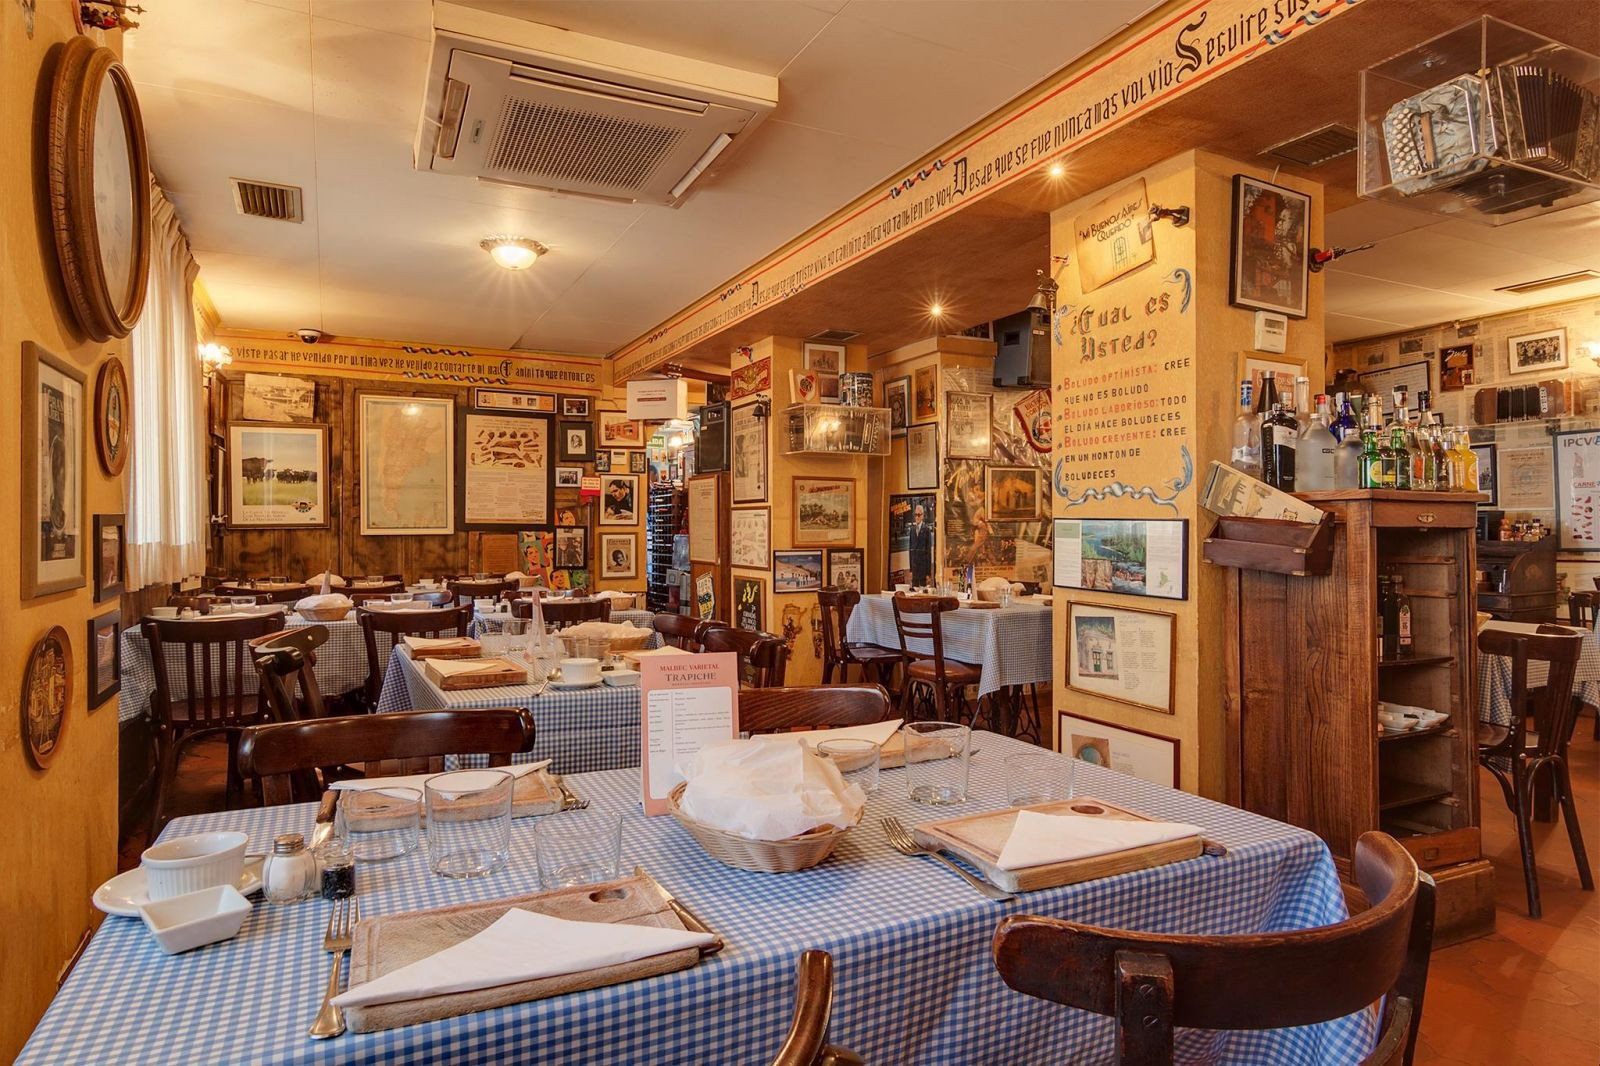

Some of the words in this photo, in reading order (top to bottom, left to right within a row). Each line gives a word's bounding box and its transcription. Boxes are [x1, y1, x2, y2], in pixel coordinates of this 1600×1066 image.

[952, 157, 993, 200] Desde
[1054, 107, 1092, 148] nunca
[1094, 92, 1119, 125] mas
[1144, 292, 1171, 316] es
[1164, 357, 1191, 371] CREE
[1083, 392, 1094, 403] NO
[1097, 389, 1109, 400] ES
[1111, 383, 1149, 398] BOLUDO
[1161, 395, 1187, 407] TODO
[1064, 424, 1074, 434] EL
[1095, 419, 1118, 430] HACE
[1121, 411, 1181, 427] BOLUDECES
[1160, 426, 1187, 437] CREE
[1065, 455, 1076, 463] EN
[1078, 452, 1089, 461] UN
[1092, 449, 1127, 461] MONTON
[1130, 447, 1141, 457] DE
[1064, 469, 1116, 481] BOLUDECES
[665, 672, 717, 682] TRAPICHE
